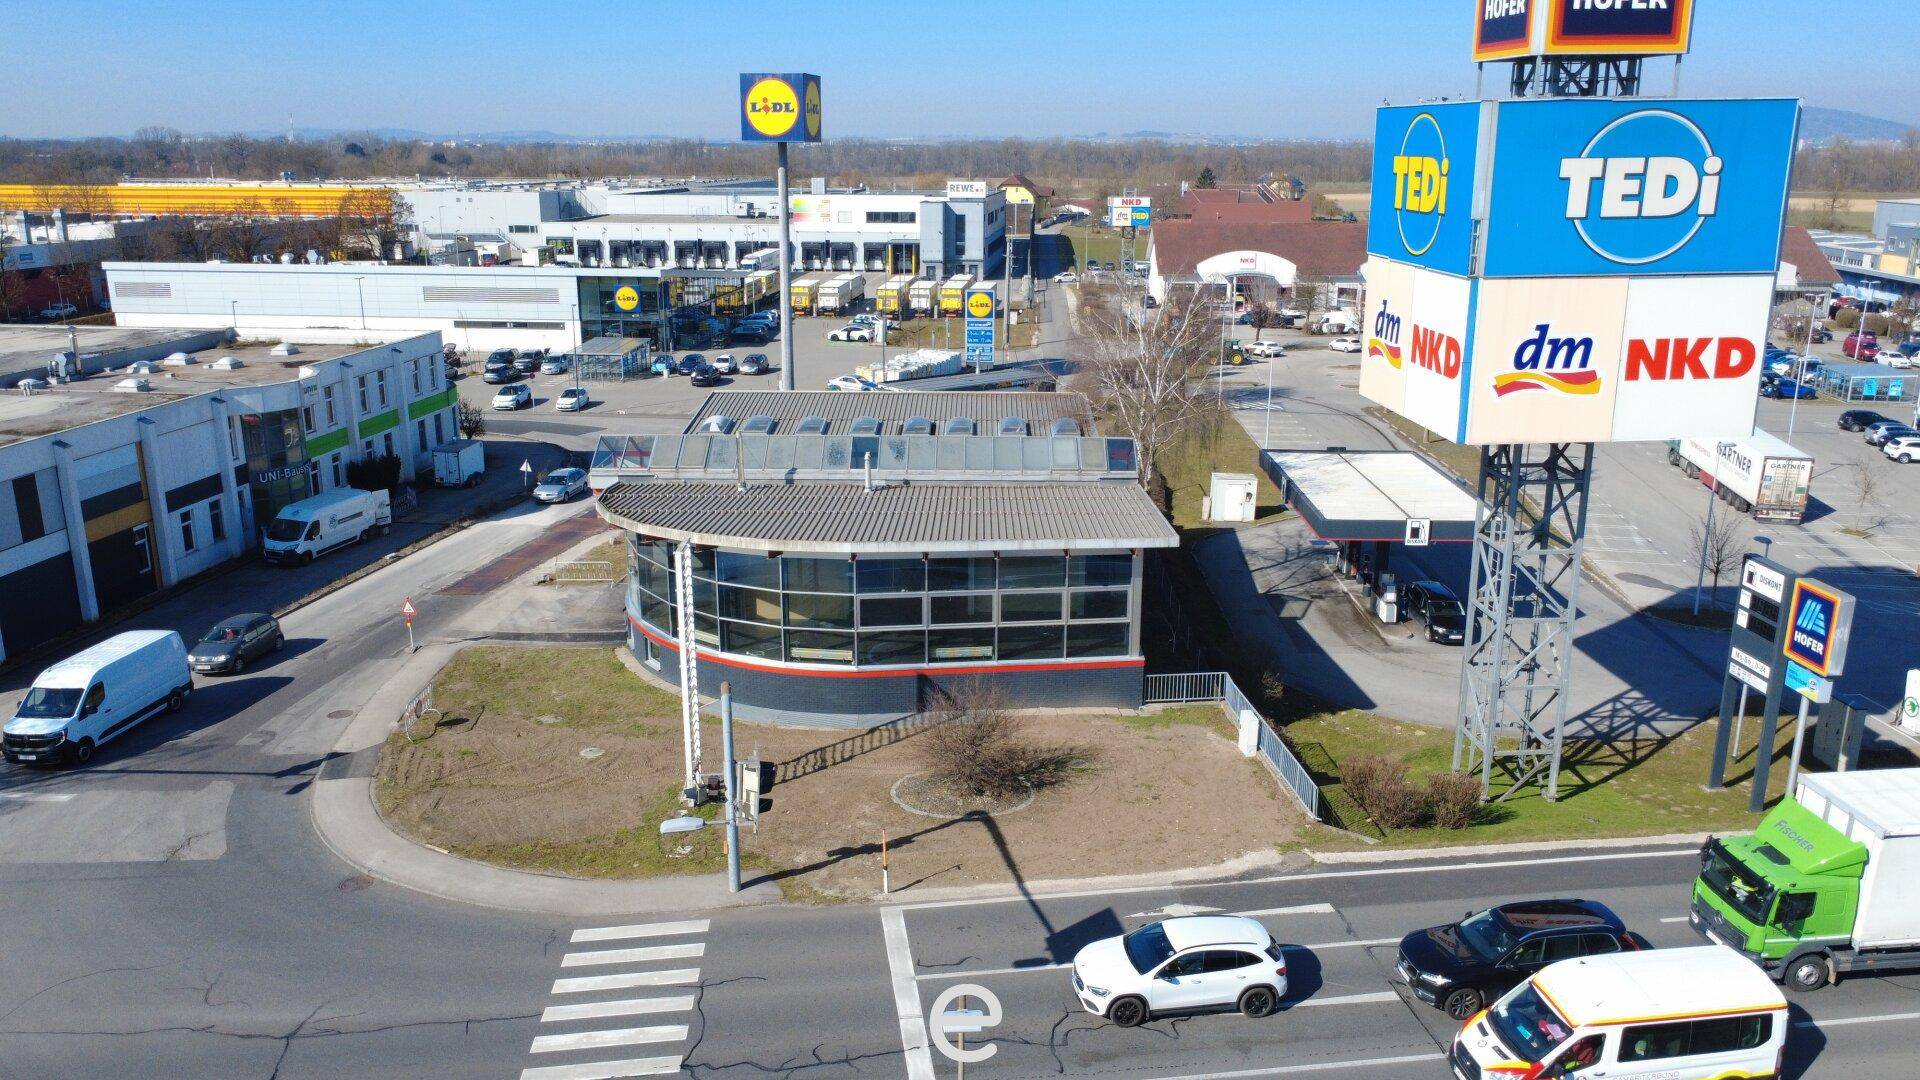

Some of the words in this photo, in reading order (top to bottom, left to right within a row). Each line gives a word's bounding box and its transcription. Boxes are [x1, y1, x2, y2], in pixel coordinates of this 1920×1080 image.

[1121, 198, 1142, 206] NKD
[1393, 155, 1449, 216] TEDi
[1559, 155, 1724, 219] TEDi
[1375, 299, 1401, 345] dm
[1411, 323, 1461, 380] NKD
[1513, 323, 1594, 371] dm
[1624, 337, 1756, 381] NKD
[1760, 574, 1782, 592] DISKONT
[1794, 630, 1824, 656] HOFER
